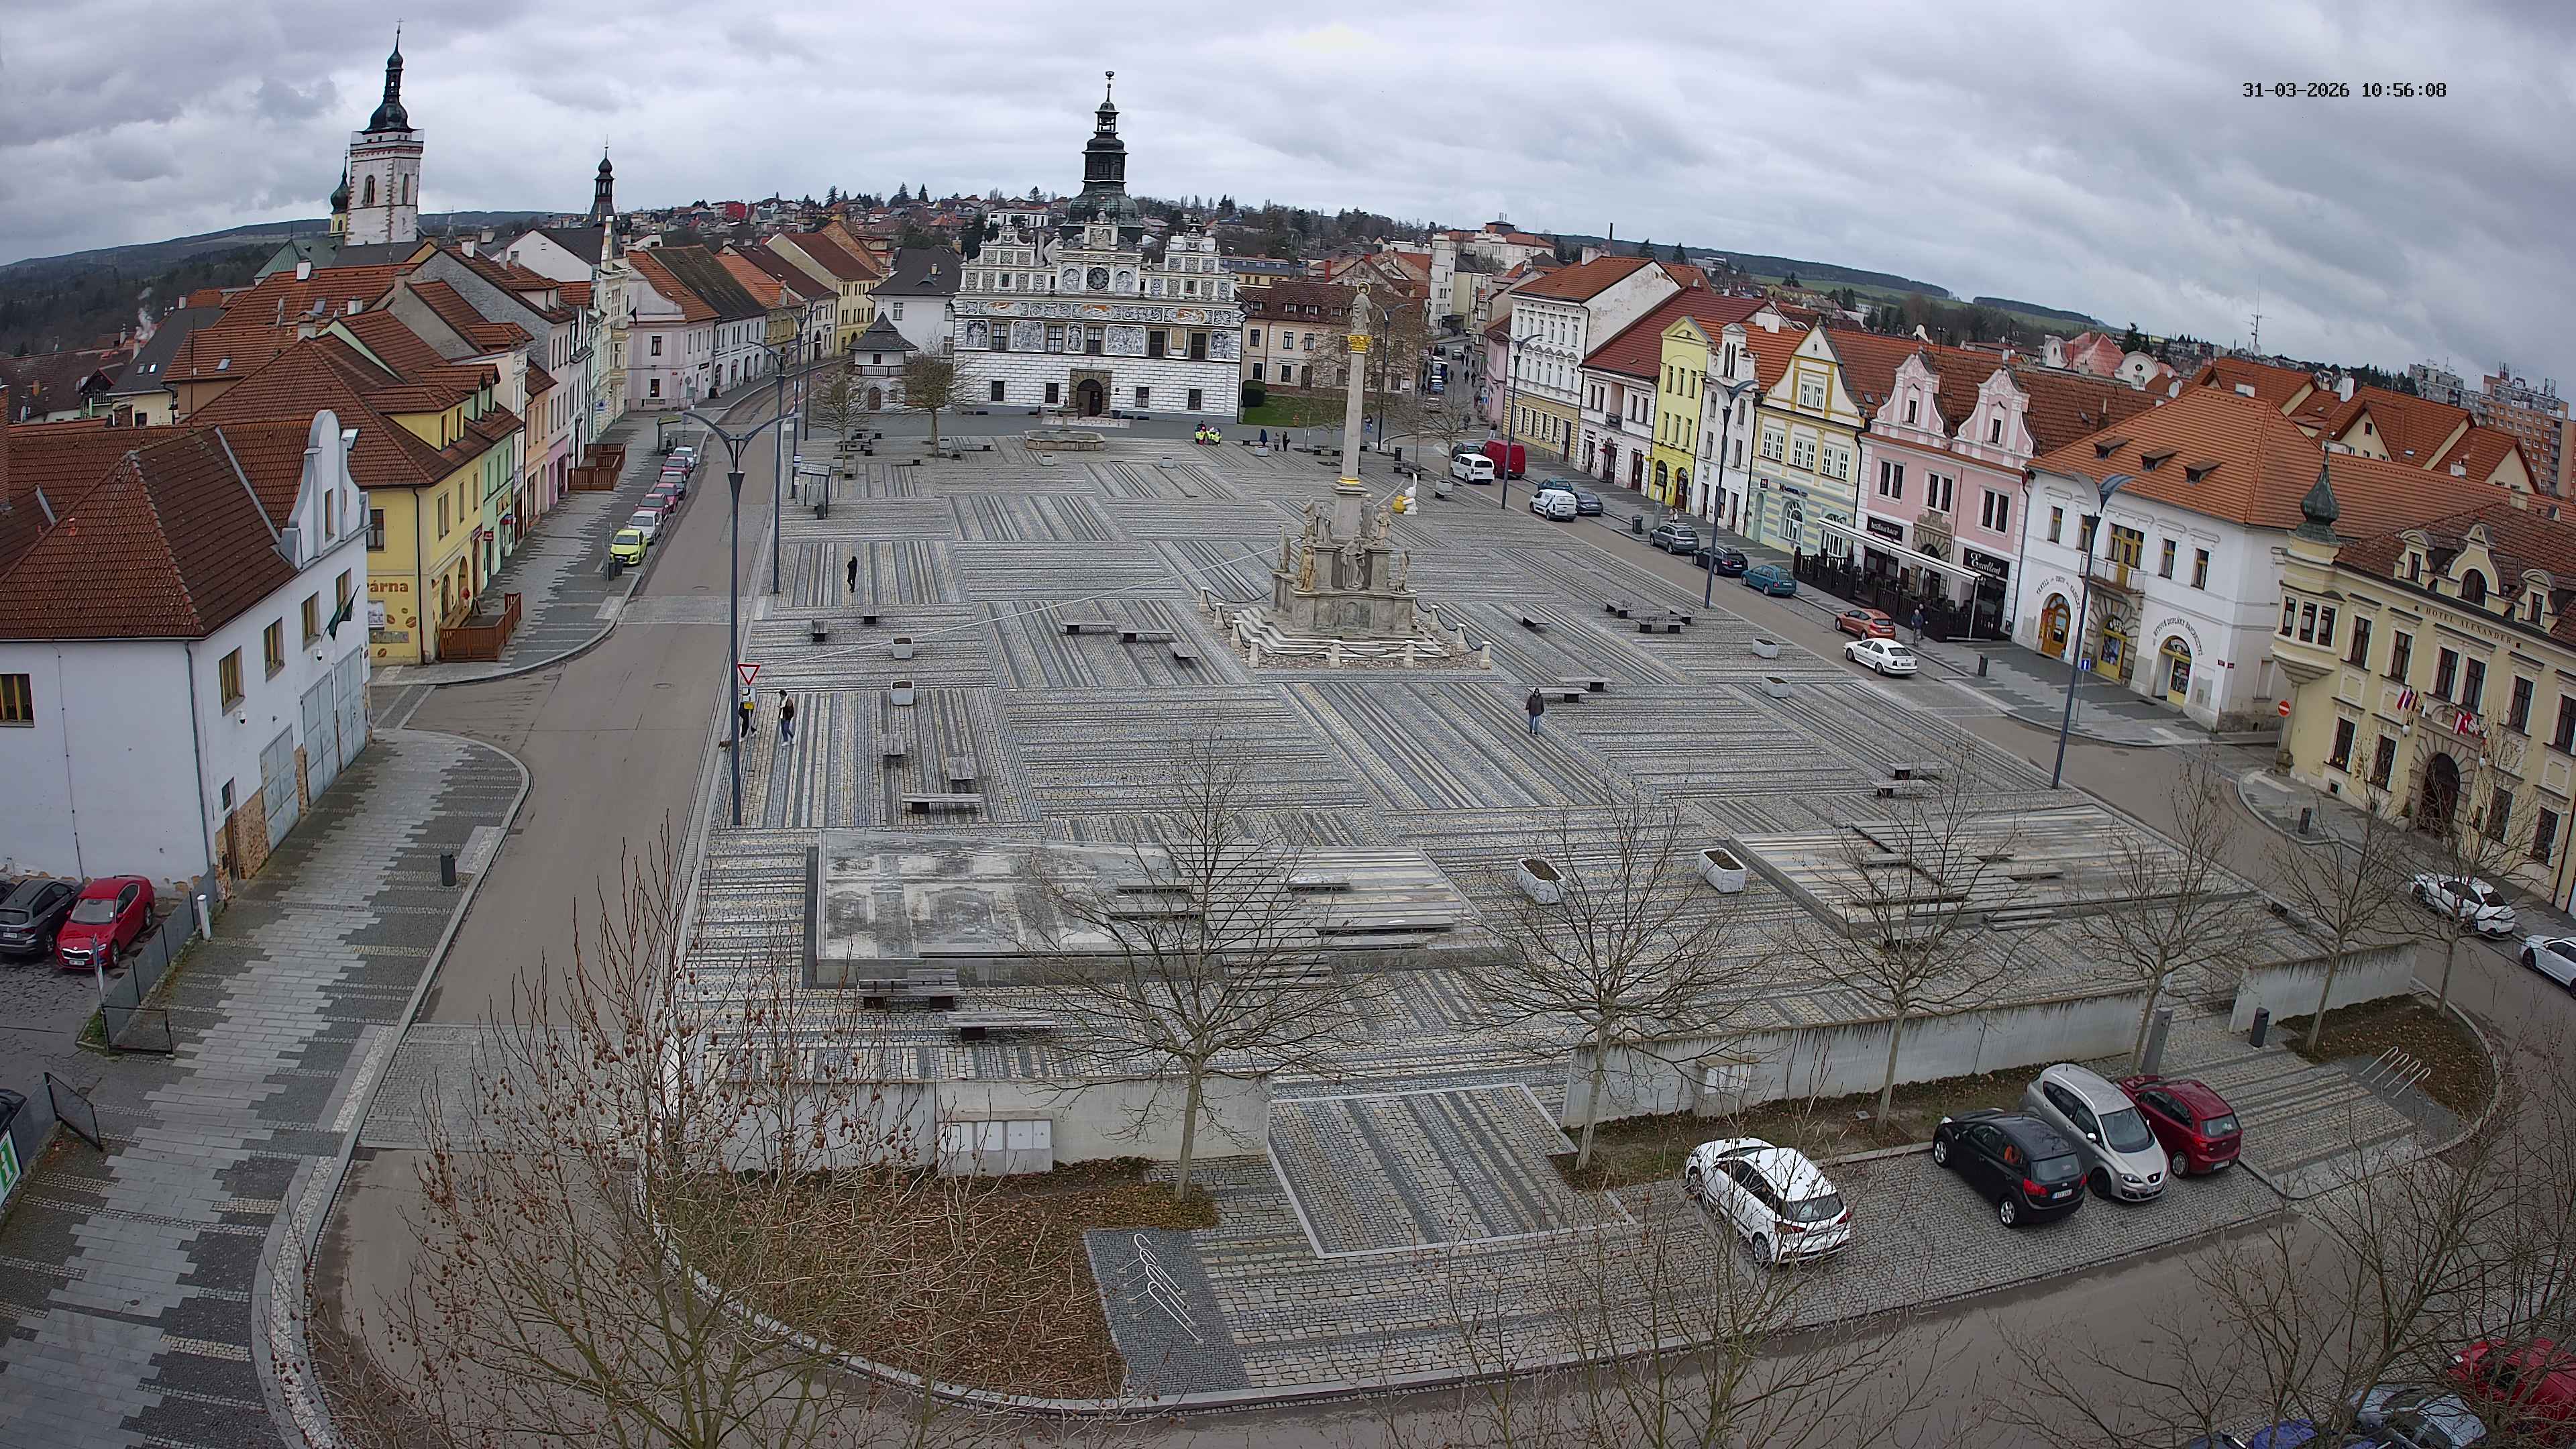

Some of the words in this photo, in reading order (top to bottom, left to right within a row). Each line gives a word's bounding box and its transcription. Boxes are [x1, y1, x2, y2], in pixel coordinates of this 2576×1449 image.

[1970, 552, 2001, 575] Excellent
[2426, 606, 2455, 624] HOTEL
[2459, 619, 2512, 645] ALEXANDER
